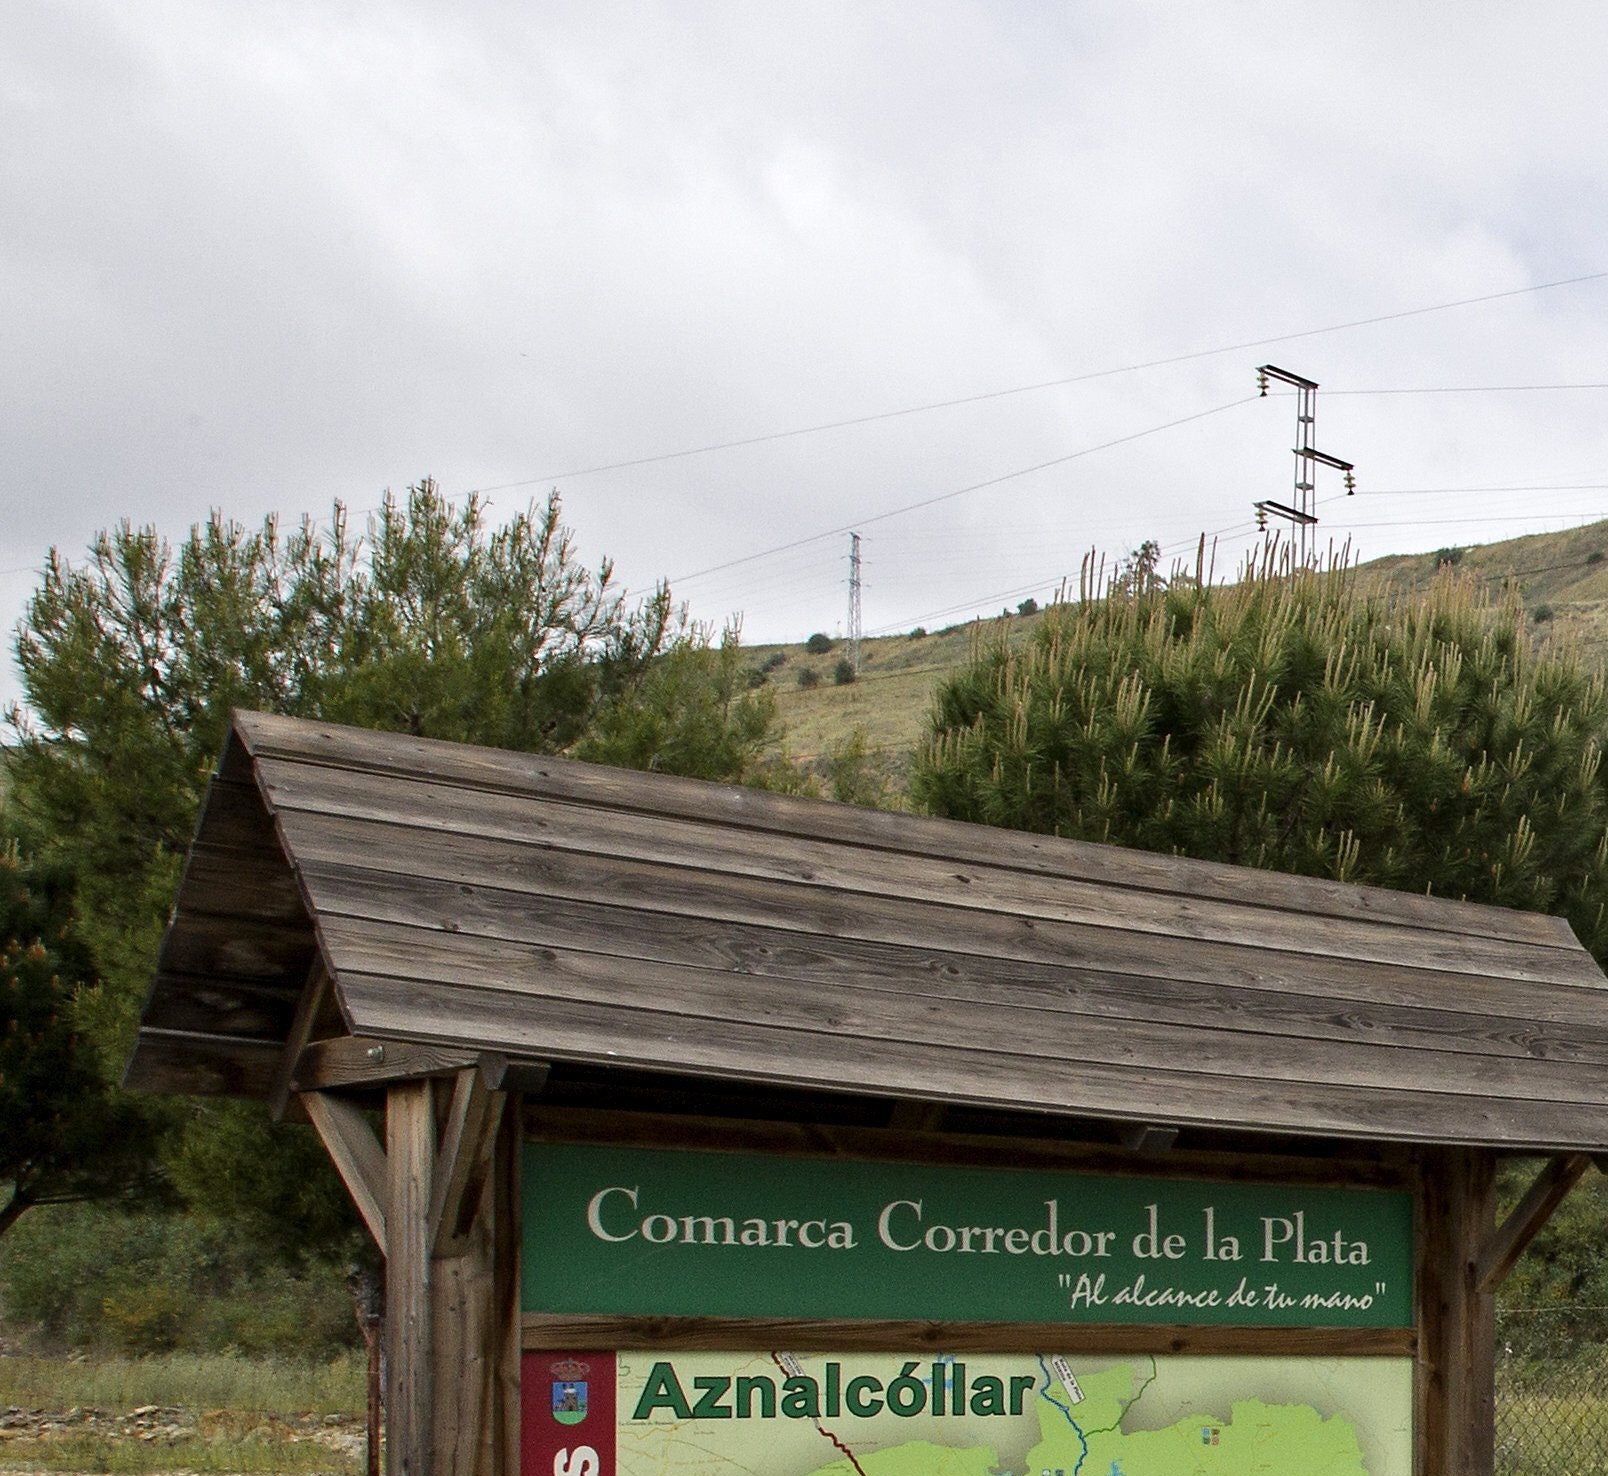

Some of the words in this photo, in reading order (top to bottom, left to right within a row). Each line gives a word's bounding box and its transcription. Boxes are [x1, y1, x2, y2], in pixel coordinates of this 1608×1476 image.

[587, 1185, 858, 1249] Comarca
[878, 1199, 1116, 1258] Corredor
[1132, 1203, 1186, 1260] de
[1202, 1206, 1243, 1262] la
[1259, 1210, 1372, 1266] Plata
[1058, 1272, 1110, 1310] "Al
[1111, 1274, 1222, 1309] alcance
[1224, 1276, 1260, 1308] de
[1263, 1282, 1298, 1310] tu
[1299, 1281, 1386, 1311] mano"
[632, 1361, 1036, 1420] Aznalcóllar
